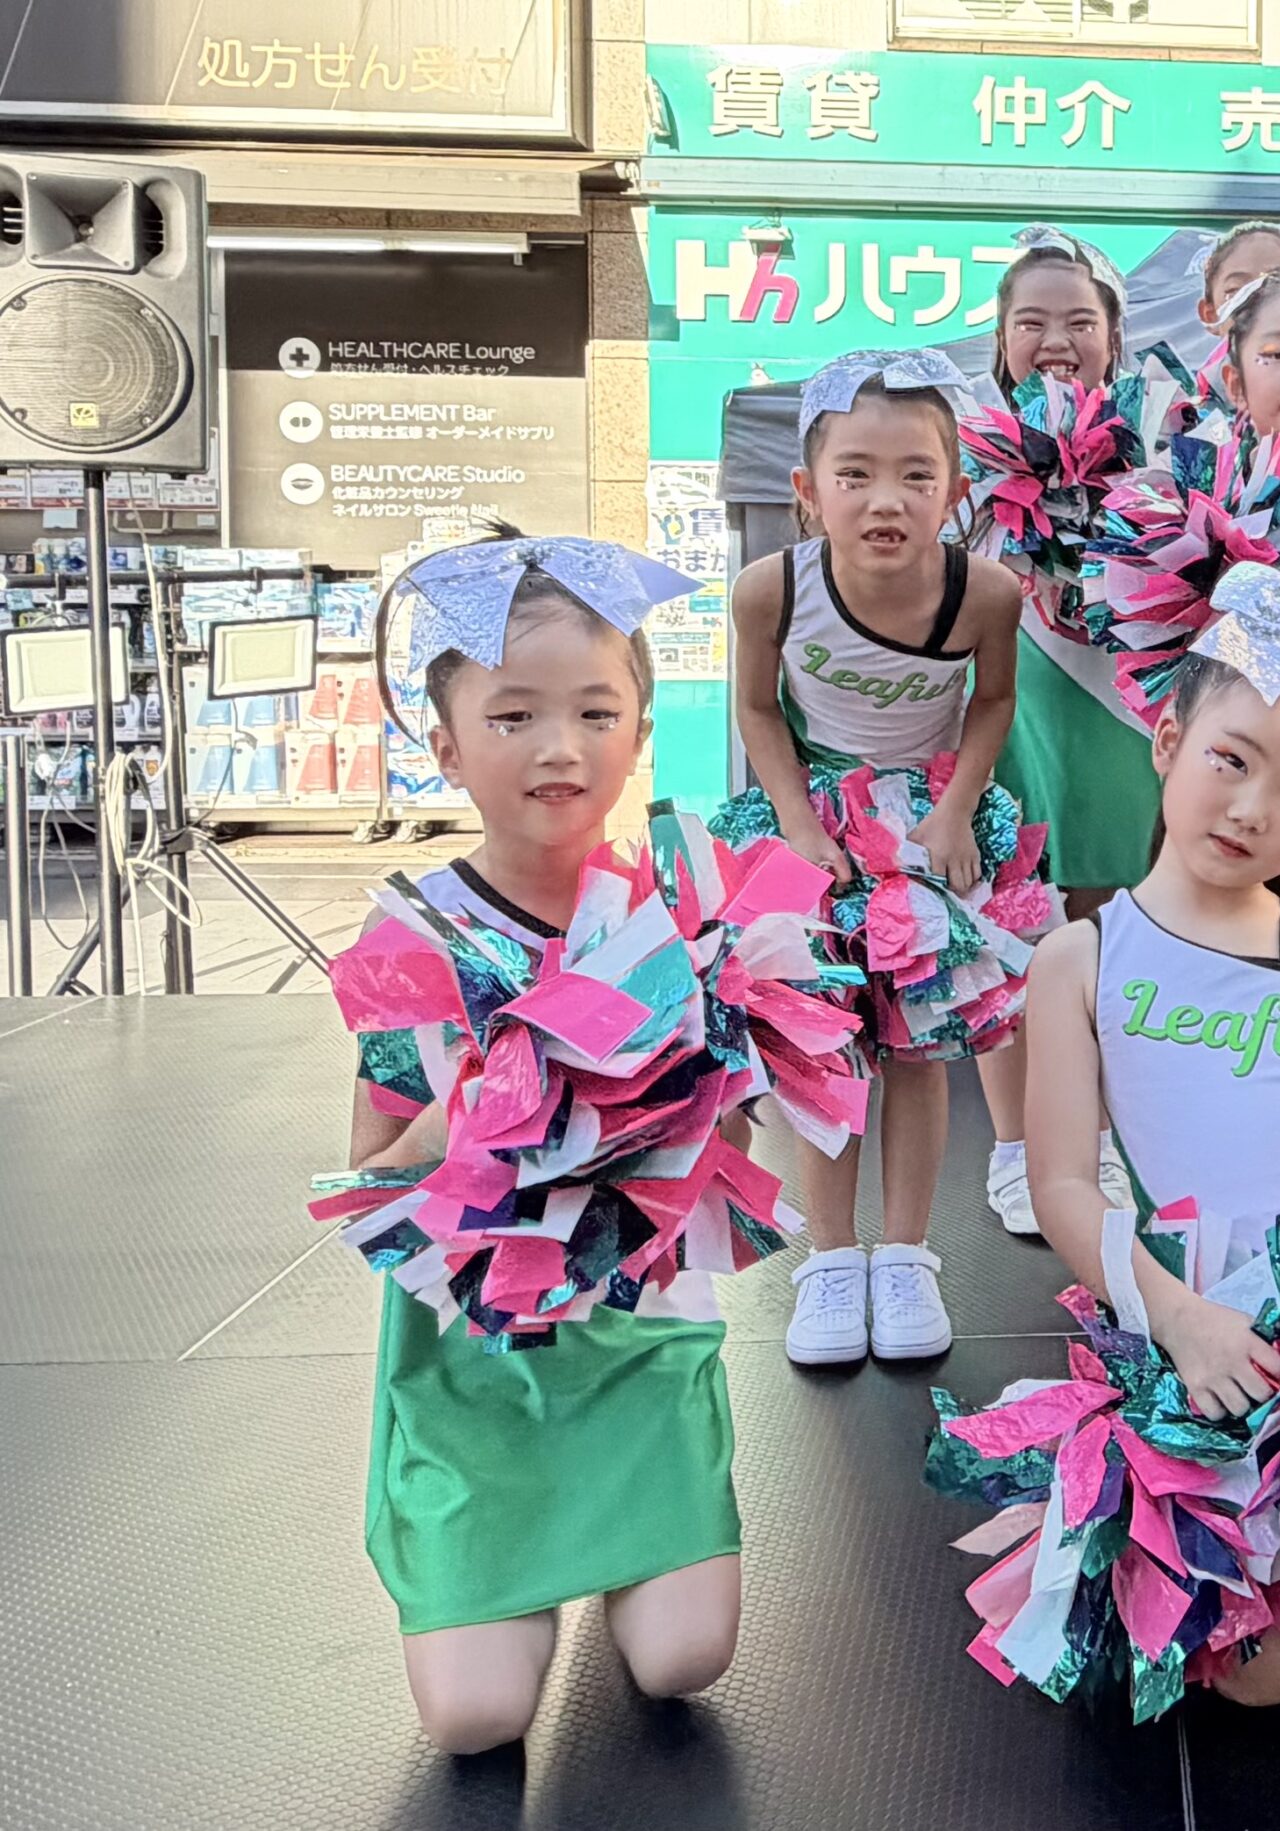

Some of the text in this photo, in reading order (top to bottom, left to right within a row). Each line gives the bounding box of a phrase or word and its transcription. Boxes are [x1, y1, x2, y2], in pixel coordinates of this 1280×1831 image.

[198, 36, 511, 95] 処方せん受付
[705, 65, 881, 142] 賃貸
[972, 75, 1132, 150] 仲介
[328, 341, 536, 364] HEALTHCARE Lounge
[328, 403, 497, 422] SUPPLEMENT Bar
[330, 464, 525, 484] BEAUTYCARE Studio
[332, 486, 465, 501] 化粧品カウンセリング
